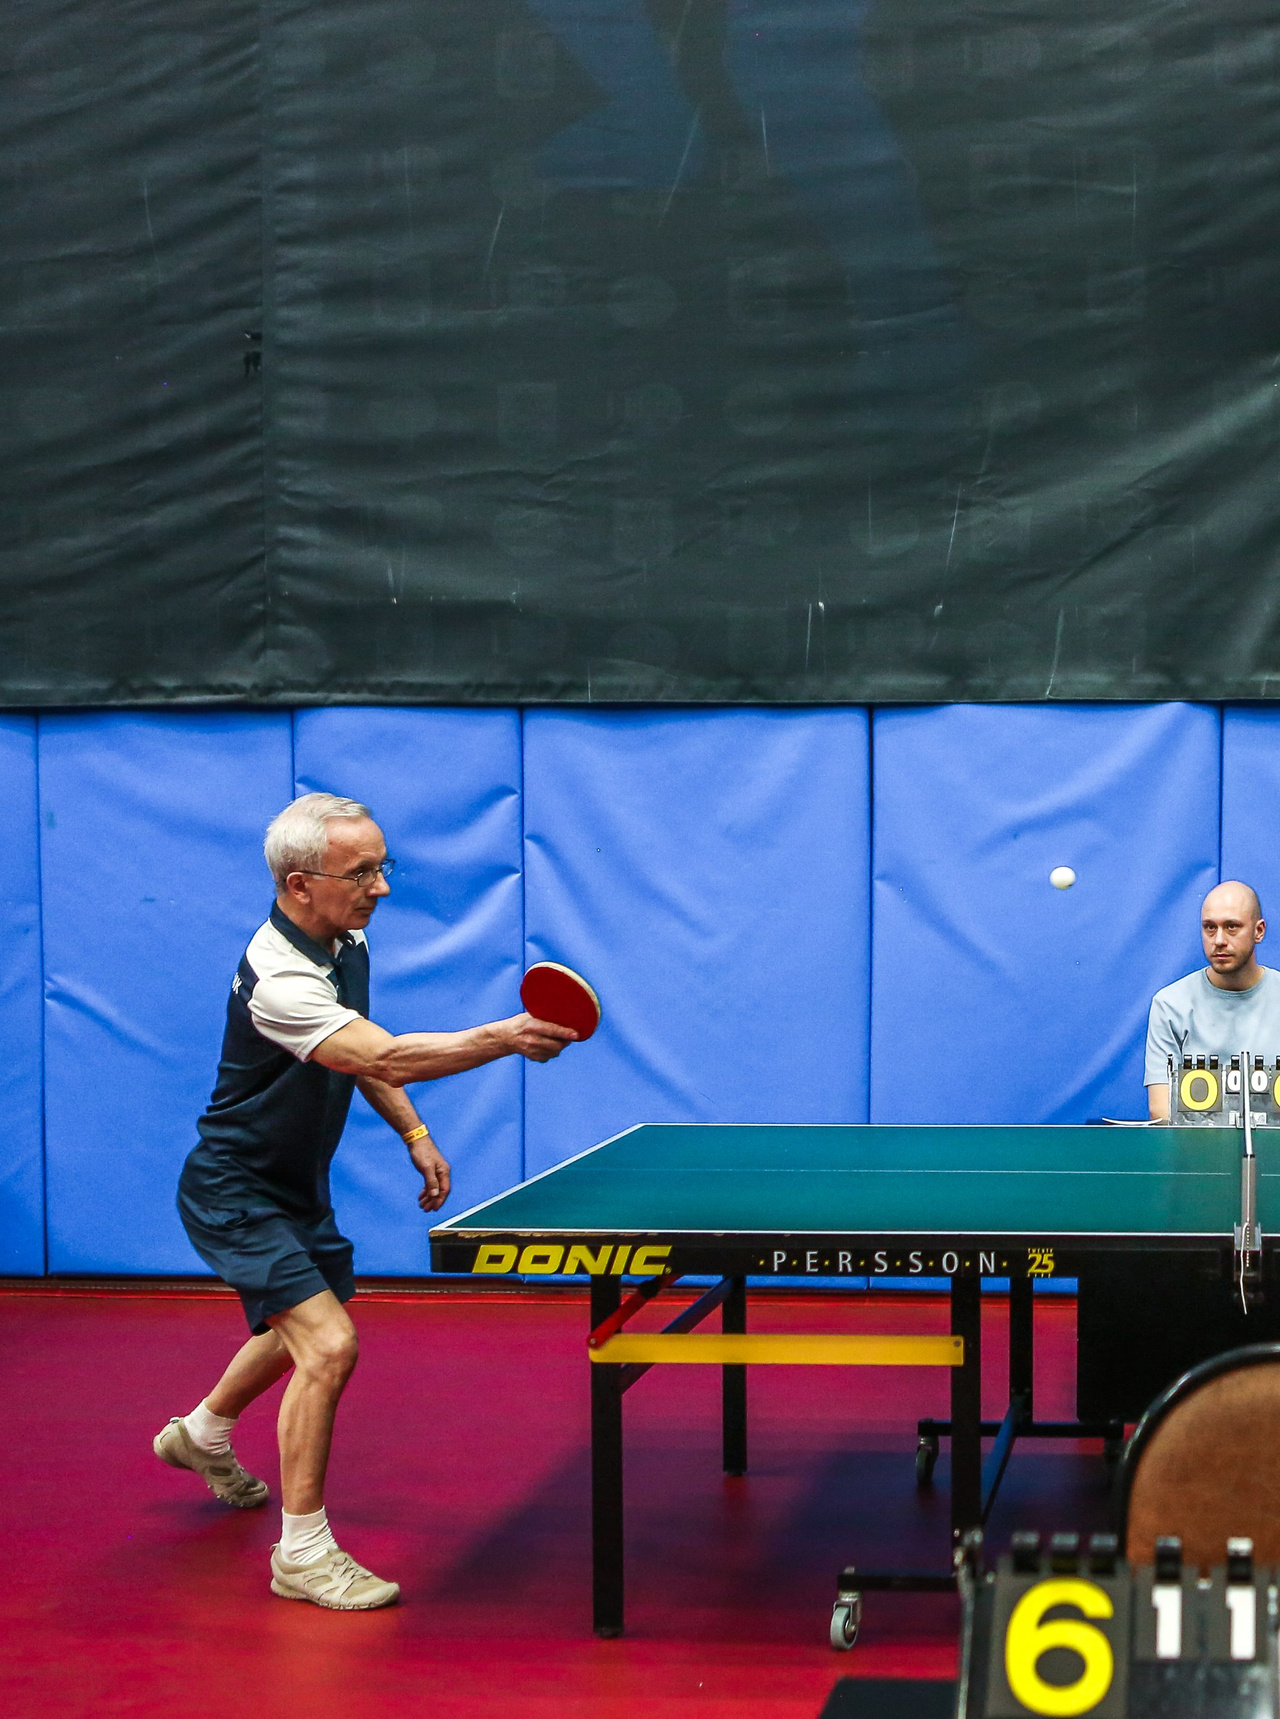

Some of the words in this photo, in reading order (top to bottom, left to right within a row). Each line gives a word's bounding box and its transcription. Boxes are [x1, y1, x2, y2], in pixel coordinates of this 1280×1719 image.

[1180, 1069, 1218, 1111] 0
[1251, 1070, 1268, 1092] 0
[472, 1245, 672, 1275] DONIC
[1028, 1253, 1055, 1273] 25
[1005, 1576, 1114, 1717] 6
